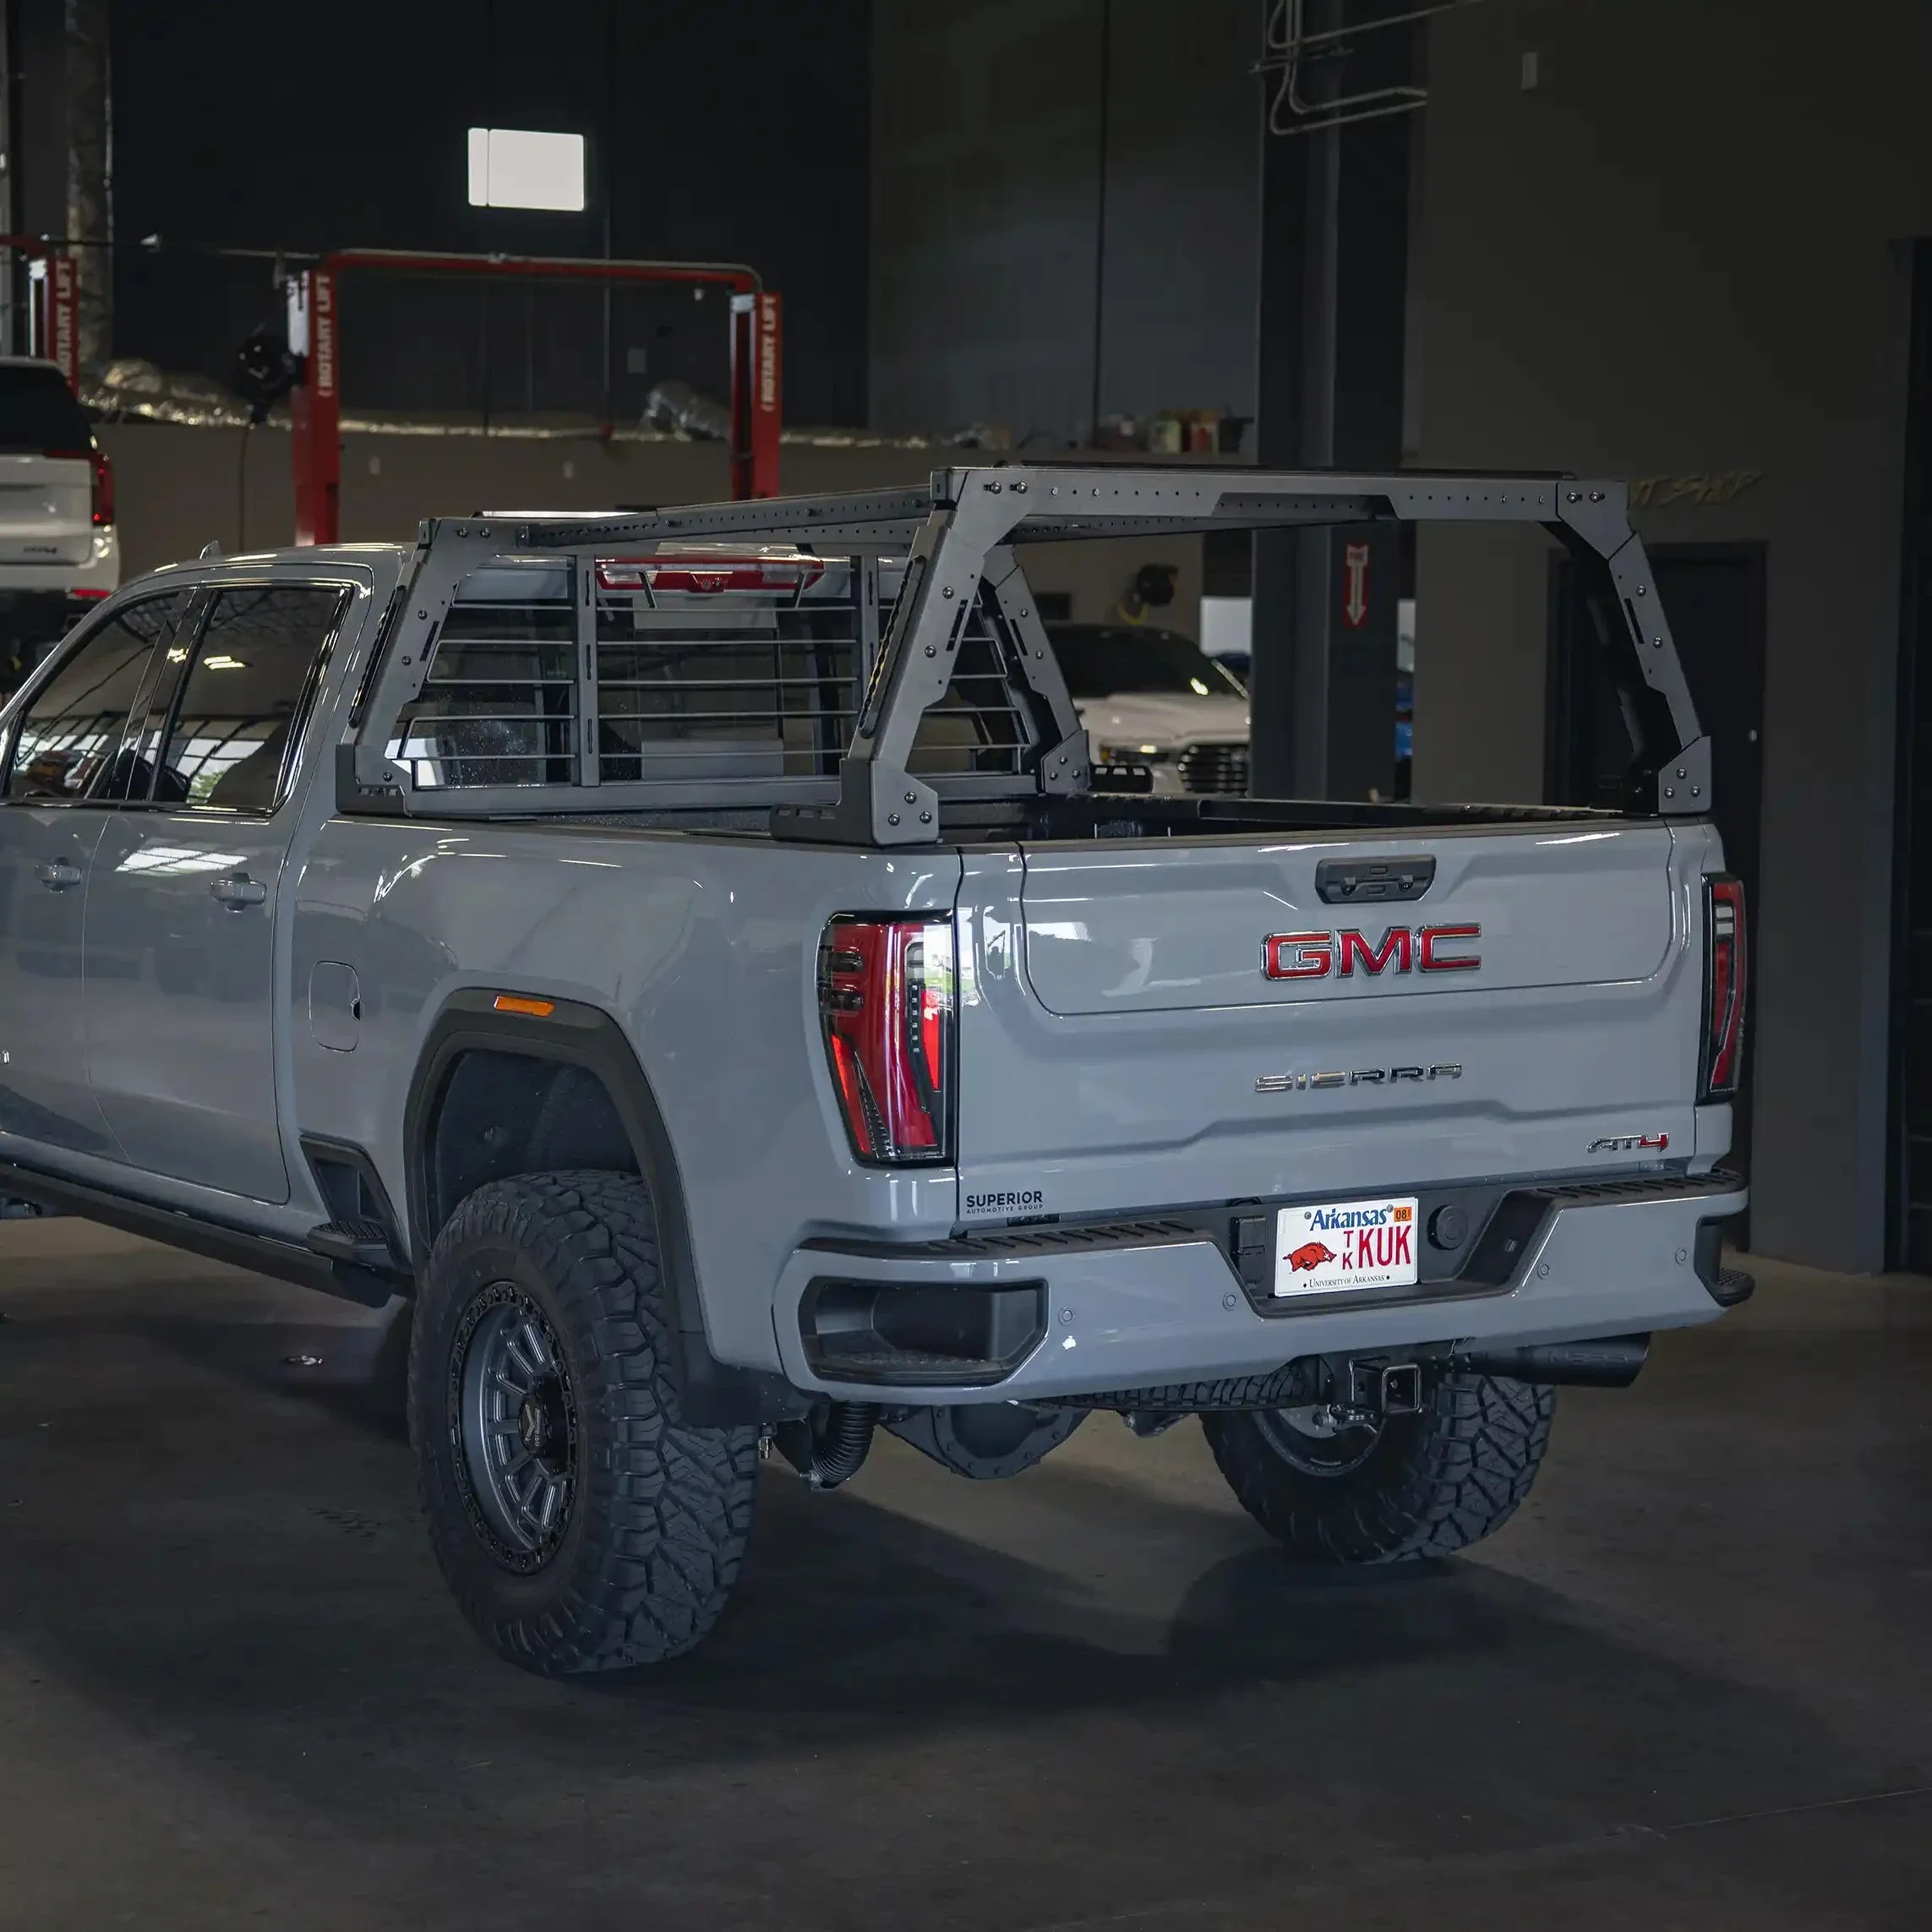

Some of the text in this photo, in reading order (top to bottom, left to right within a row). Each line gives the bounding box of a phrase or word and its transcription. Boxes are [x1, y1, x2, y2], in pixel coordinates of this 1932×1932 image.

[56, 260, 71, 298] LIFT
[315, 276, 332, 387] ROTARY LIFT
[761, 297, 776, 402] ROTARY LIFT
[1260, 922, 1482, 980] GMC
[1255, 1063, 1462, 1093] SIERRA
[1586, 1132, 1669, 1153] AT4
[966, 1190, 1043, 1208] SUPERIOR
[1310, 1208, 1387, 1231] Arkansas
[1395, 1209, 1407, 1220] 08
[1358, 1225, 1411, 1269] KUK
[1308, 1278, 1344, 1288] UNIVERSITY
[1352, 1274, 1385, 1285] ARKANSAS
